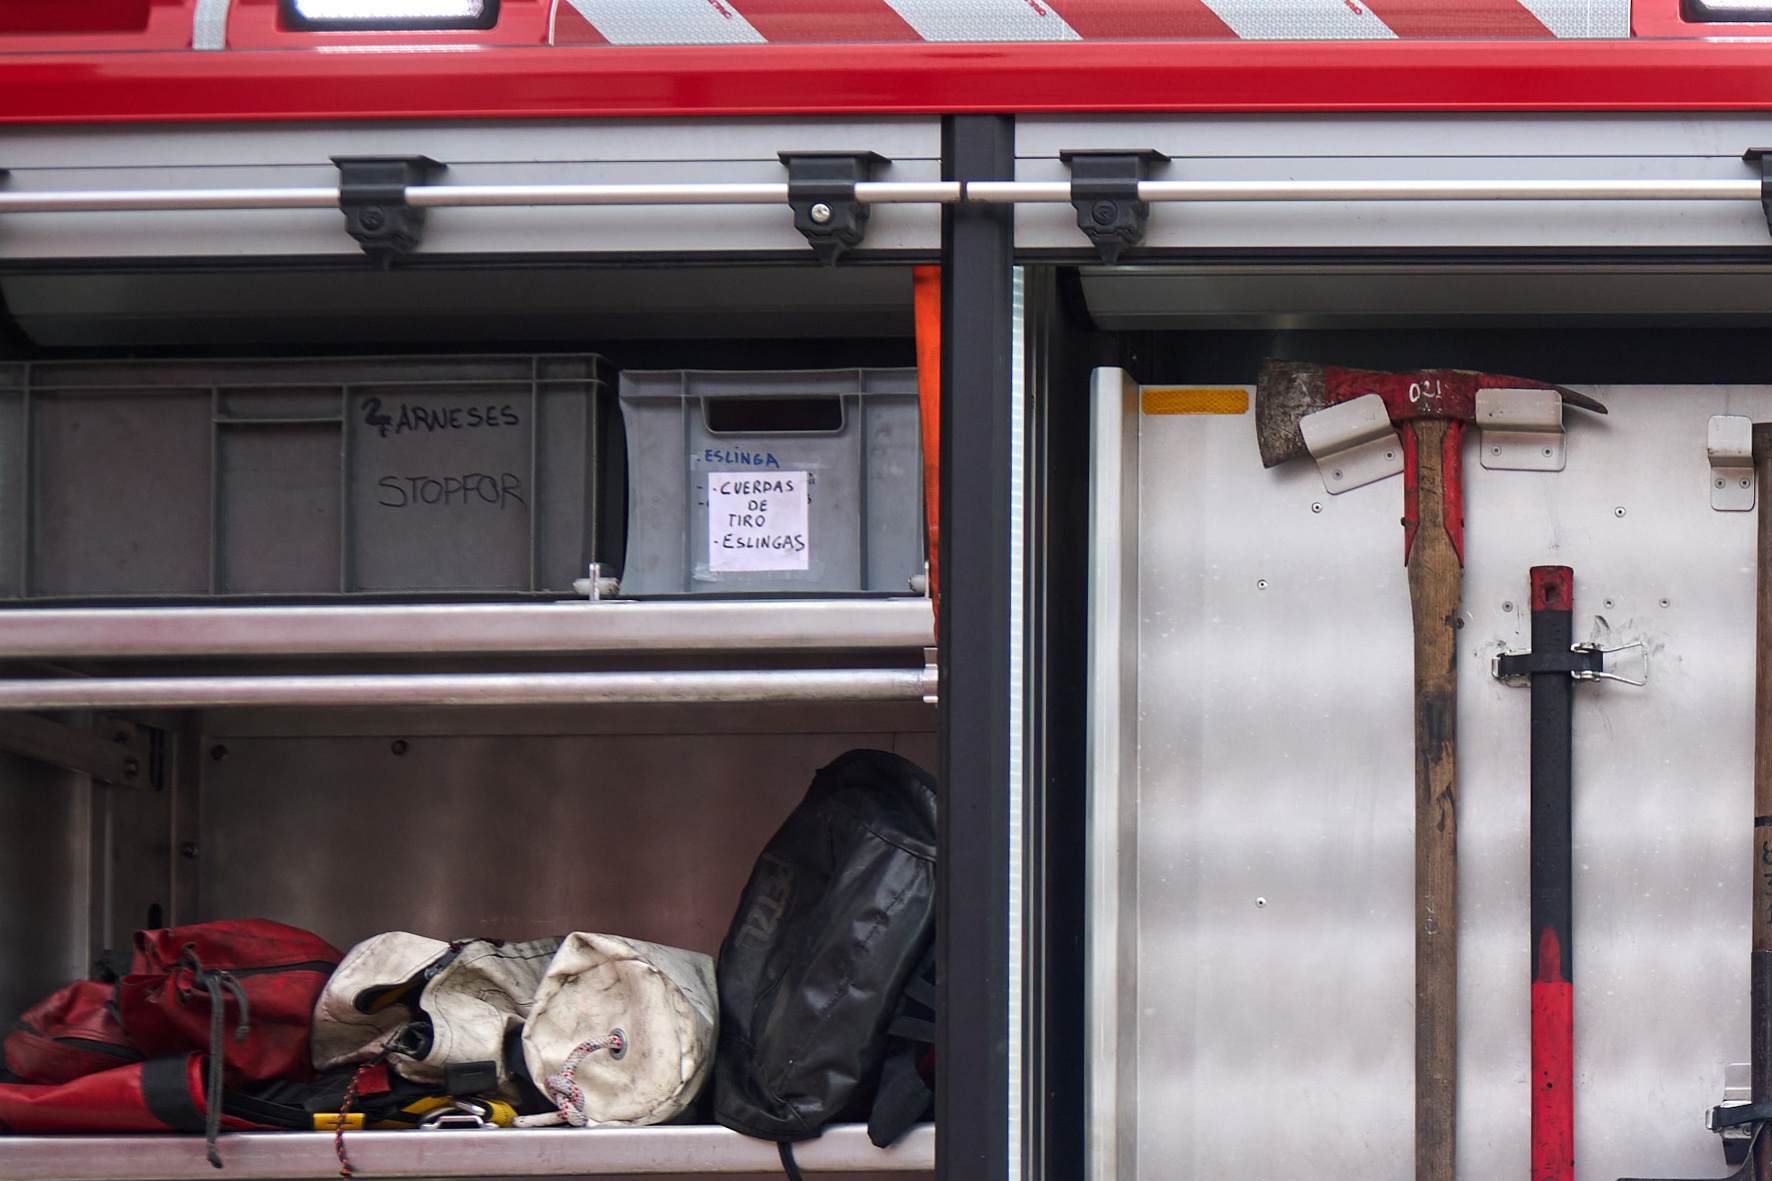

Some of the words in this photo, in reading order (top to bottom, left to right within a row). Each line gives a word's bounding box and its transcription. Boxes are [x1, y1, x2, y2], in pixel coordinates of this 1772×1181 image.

[377, 472, 529, 511] STOPFOR
[747, 499, 768, 512] DE
[728, 513, 766, 528] TIRO
